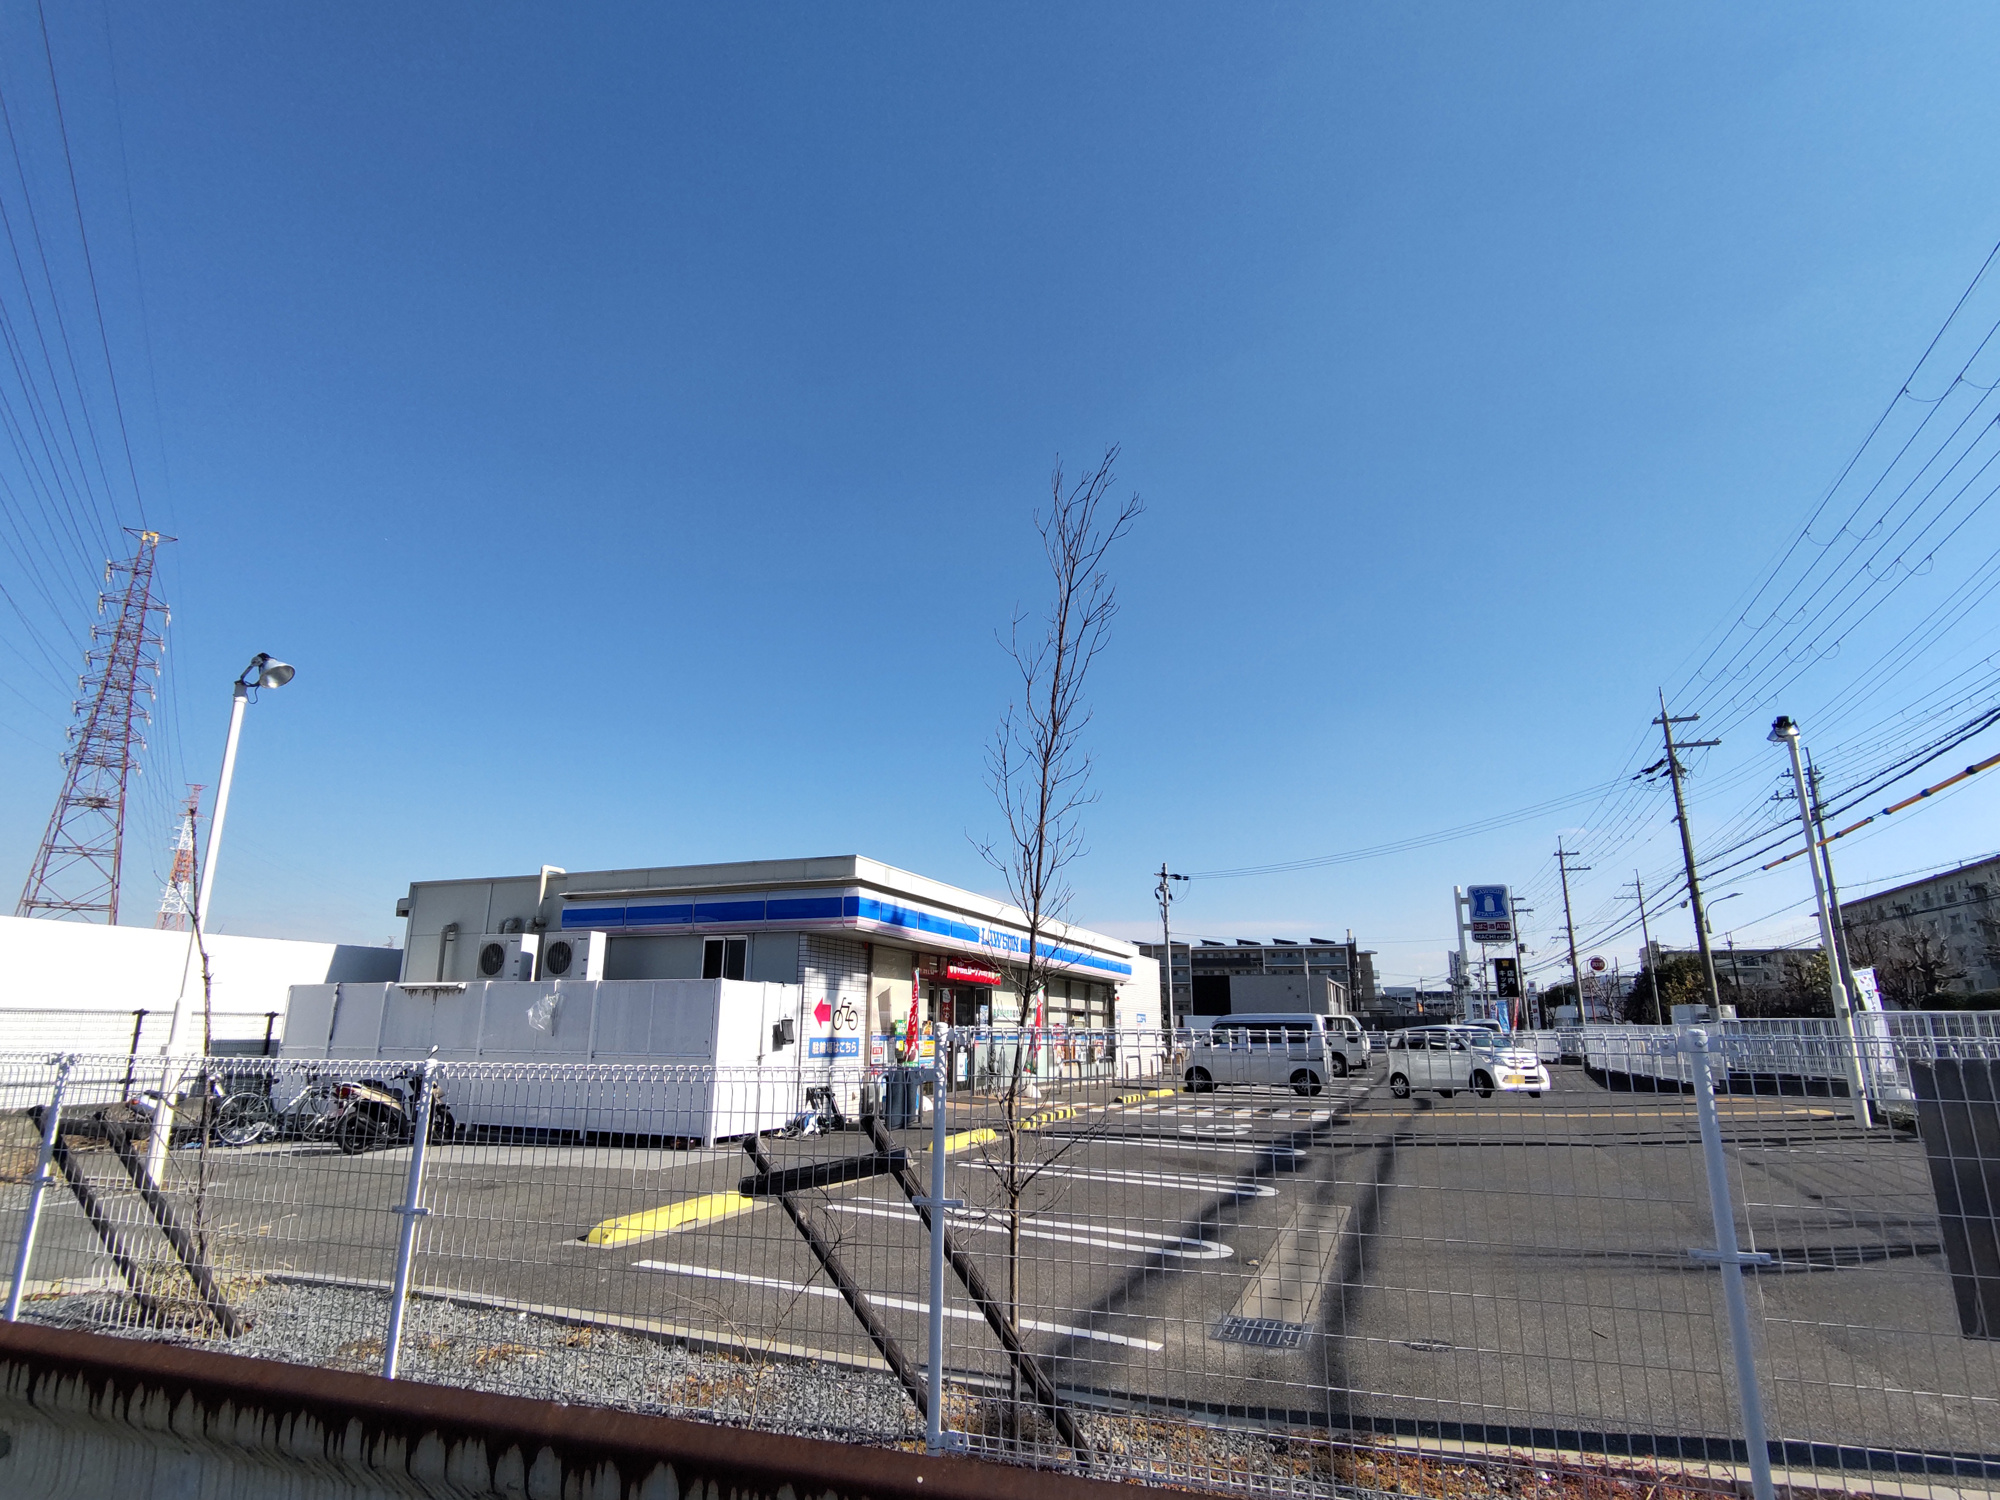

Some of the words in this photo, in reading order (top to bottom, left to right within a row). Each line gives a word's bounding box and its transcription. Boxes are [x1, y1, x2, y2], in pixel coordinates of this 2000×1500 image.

[981, 927, 1020, 952] LAWSON
[1498, 970, 1508, 996] キッチン
[1507, 970, 1515, 984] 店内
